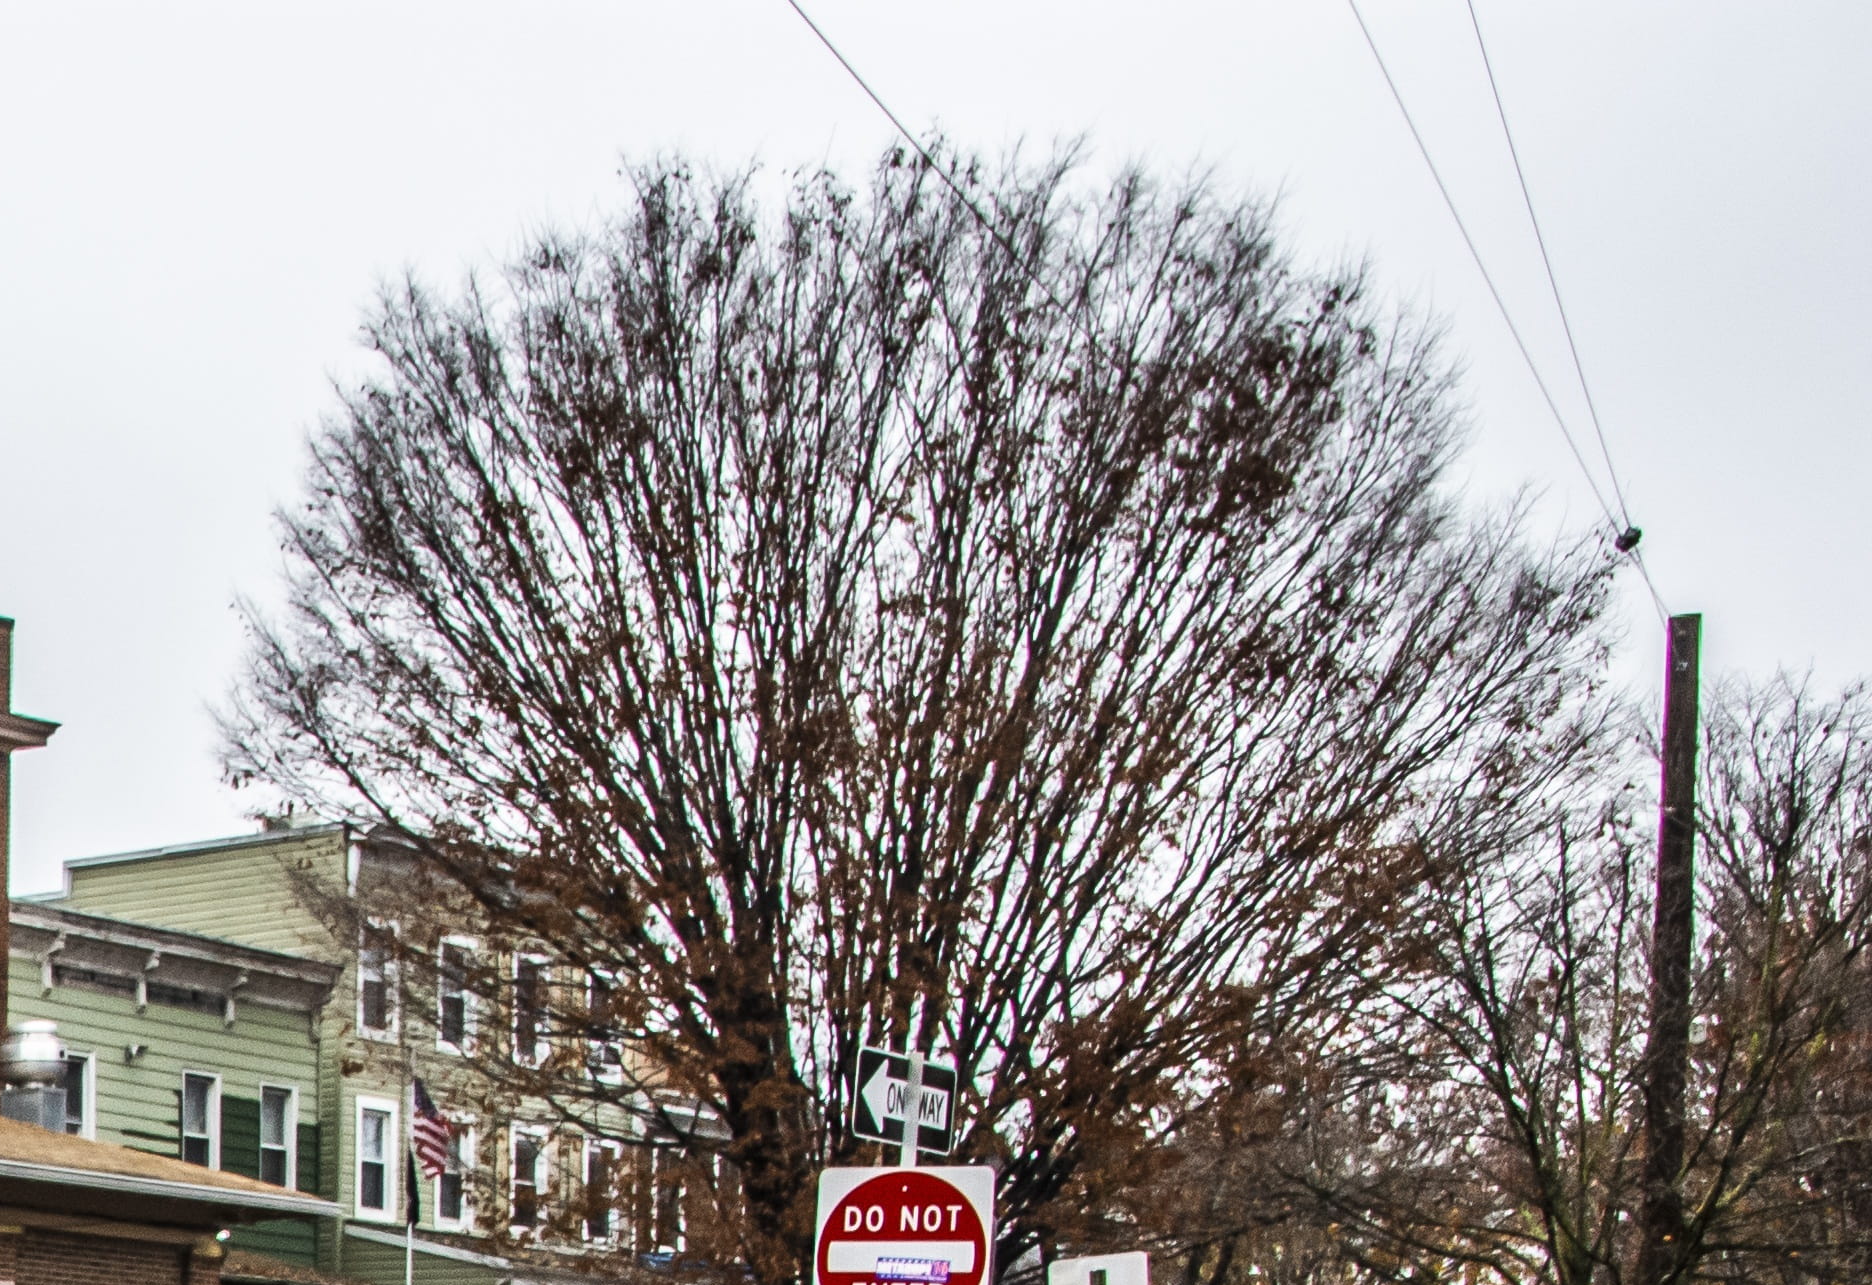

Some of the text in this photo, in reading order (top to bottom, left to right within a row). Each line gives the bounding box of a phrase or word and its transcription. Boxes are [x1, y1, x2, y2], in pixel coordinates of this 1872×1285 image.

[886, 1082, 945, 1124] ON WAY
[843, 1204, 963, 1233] DO NOT
